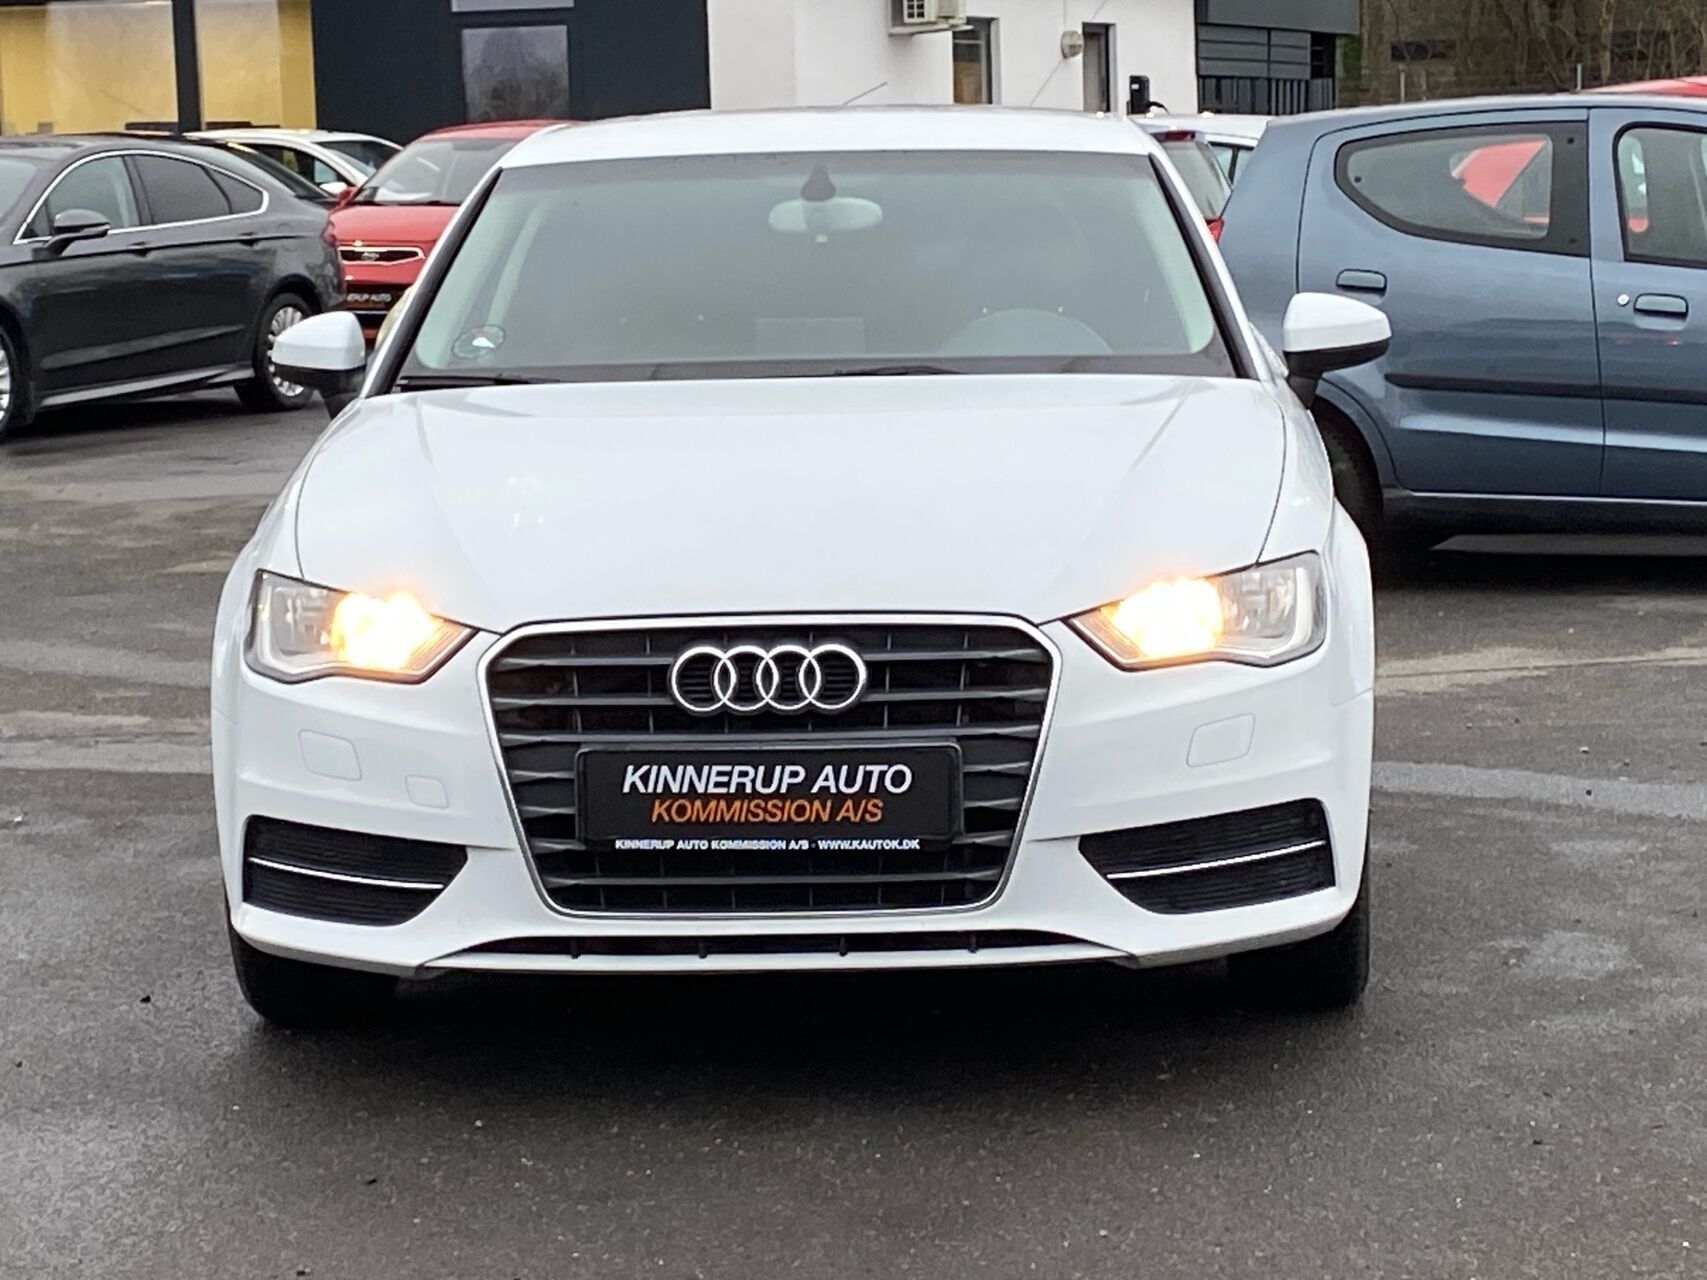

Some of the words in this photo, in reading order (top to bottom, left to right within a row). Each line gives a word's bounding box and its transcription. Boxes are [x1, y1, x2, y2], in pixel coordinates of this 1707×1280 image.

[622, 764, 806, 794] KINNERUP
[810, 763, 912, 794] AUTO
[651, 798, 832, 823] KOMMISSION
[835, 798, 884, 823] A/S
[615, 838, 675, 850] KINNERUP
[676, 838, 709, 850] AUTO
[711, 838, 787, 850] KOMMISSION
[788, 838, 810, 850] A/S
[817, 838, 921, 850] WWW.KAUTOK.DK
